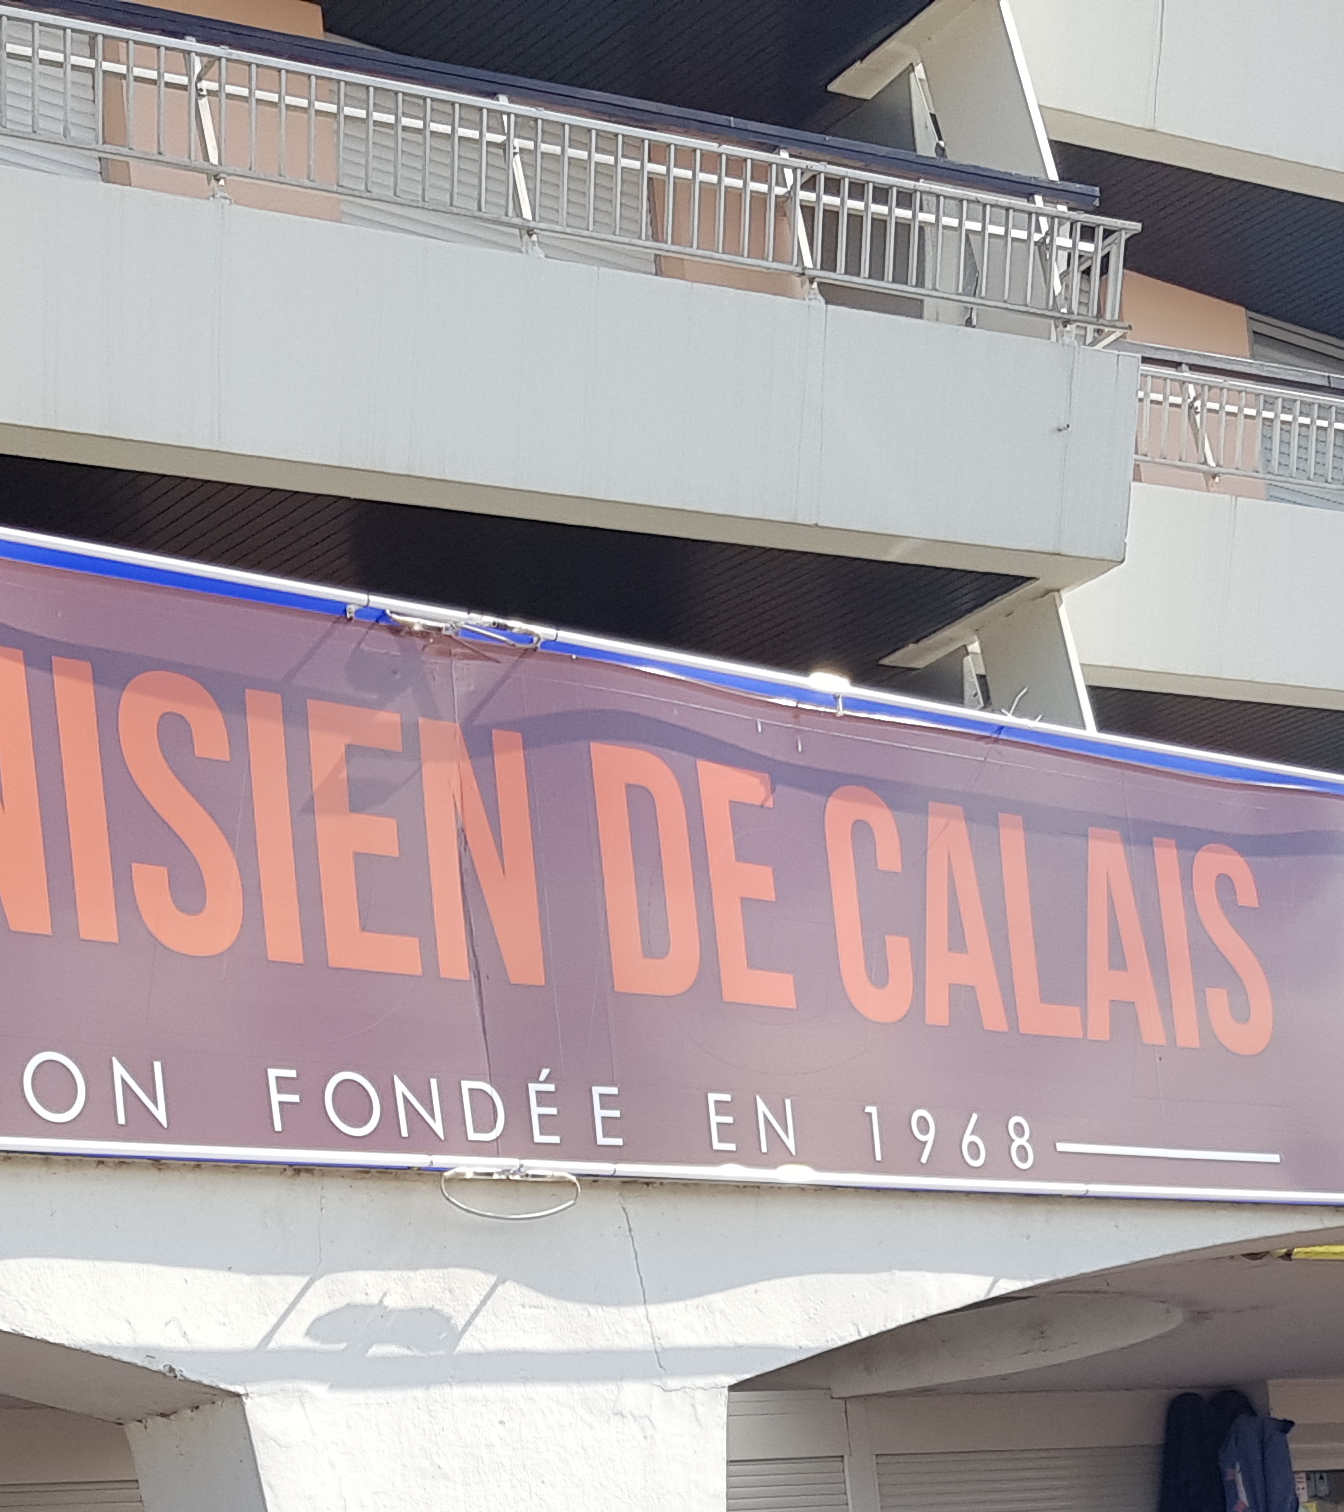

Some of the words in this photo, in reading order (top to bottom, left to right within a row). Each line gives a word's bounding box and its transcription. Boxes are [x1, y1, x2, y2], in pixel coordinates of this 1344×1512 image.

[589, 742, 797, 1010] DE
[824, 785, 1275, 1058] CALAIS
[267, 1066, 625, 1147] FONDÉE
[708, 1092, 797, 1156] EN
[864, 1104, 1035, 1171] 1968
